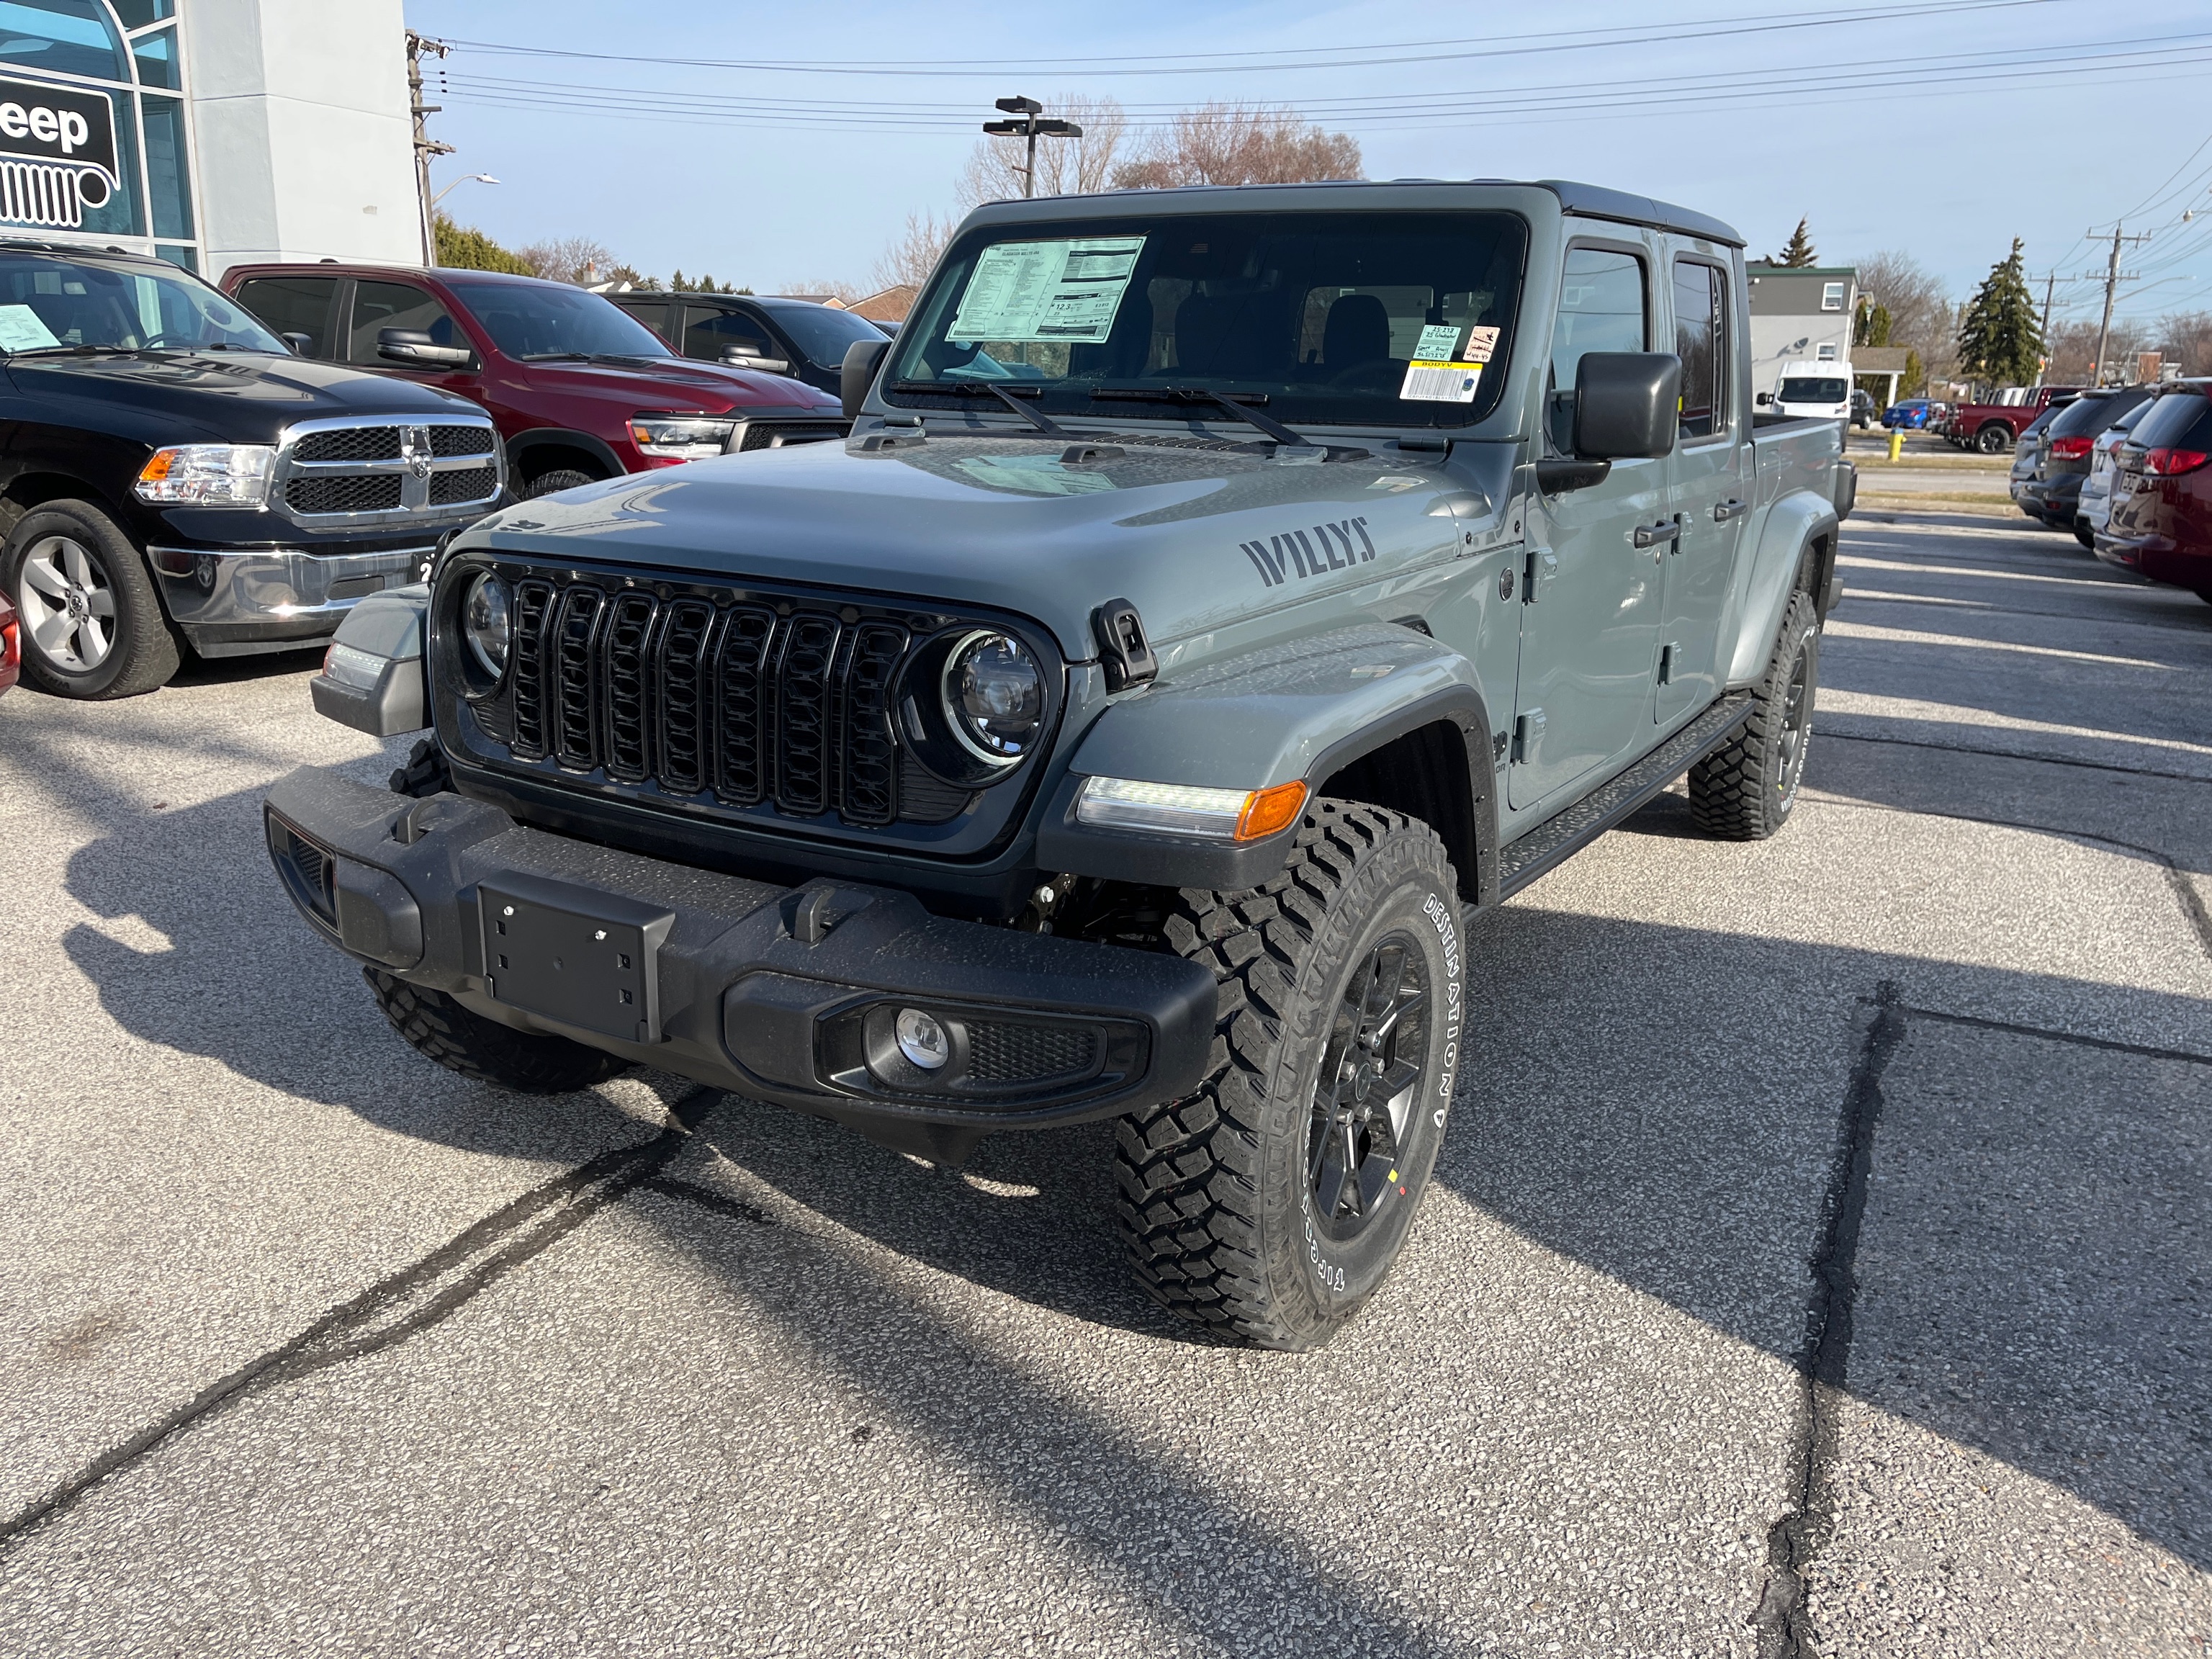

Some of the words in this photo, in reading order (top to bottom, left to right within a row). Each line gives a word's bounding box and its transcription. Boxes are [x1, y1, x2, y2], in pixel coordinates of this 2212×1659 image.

[0, 102, 89, 154] eep
[1238, 516, 1376, 587] WILLYS
[1422, 893, 1461, 1097] DESTINATION
